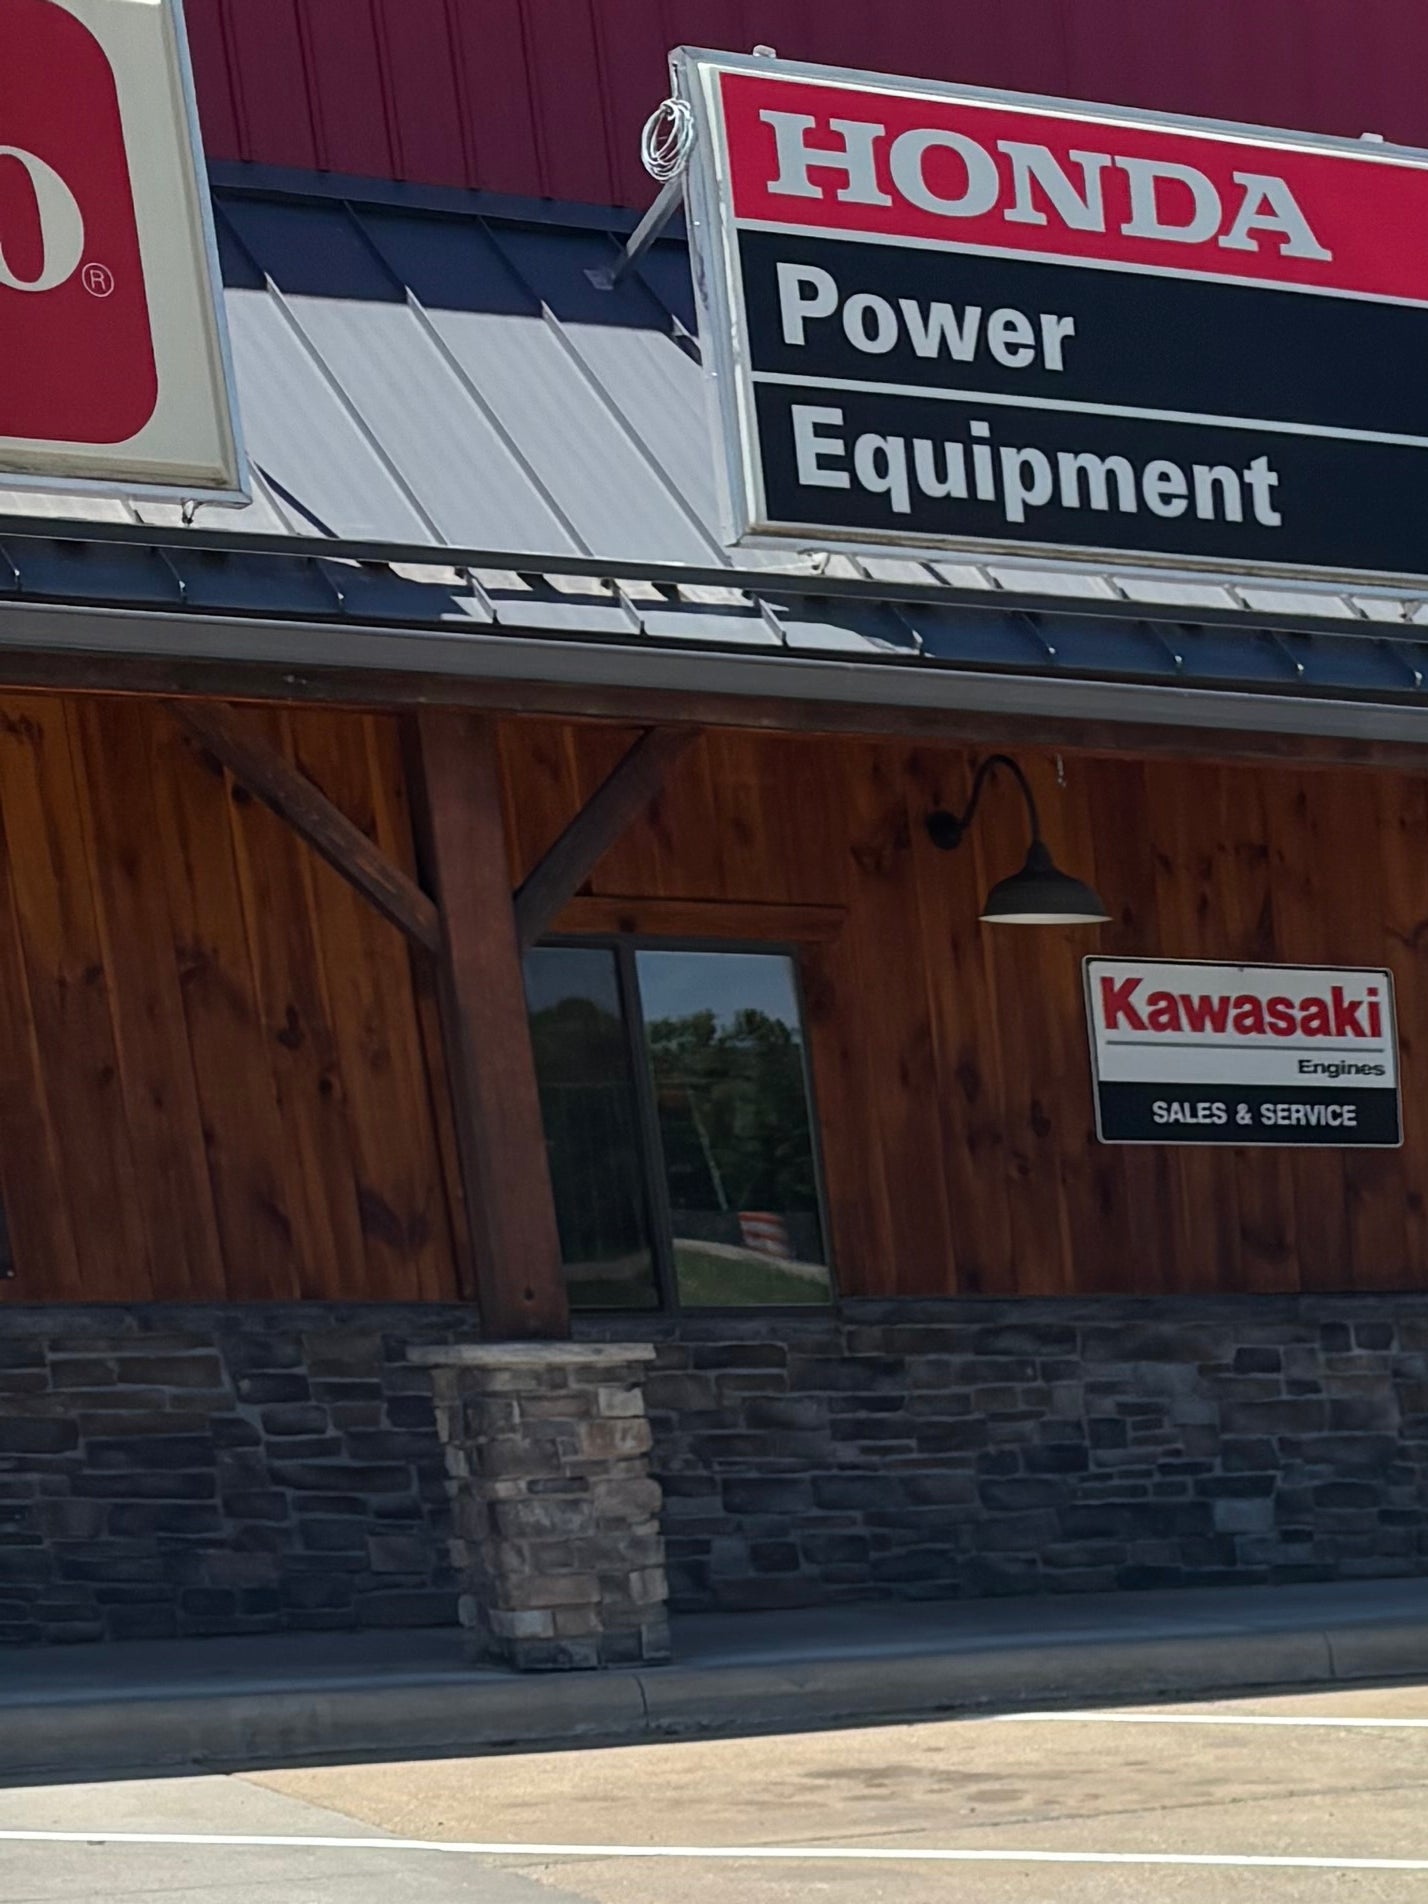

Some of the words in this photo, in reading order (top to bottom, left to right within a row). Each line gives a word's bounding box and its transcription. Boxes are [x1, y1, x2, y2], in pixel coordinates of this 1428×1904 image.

[758, 108, 1334, 262] HONDA
[776, 262, 1077, 372] Power
[790, 404, 1283, 528] Equipment
[1099, 975, 1383, 1039] Kawasaki
[1297, 1058, 1387, 1078] Engines
[1152, 1100, 1228, 1125] SALES
[1235, 1102, 1253, 1126] &
[1260, 1102, 1358, 1127] SERVICE
